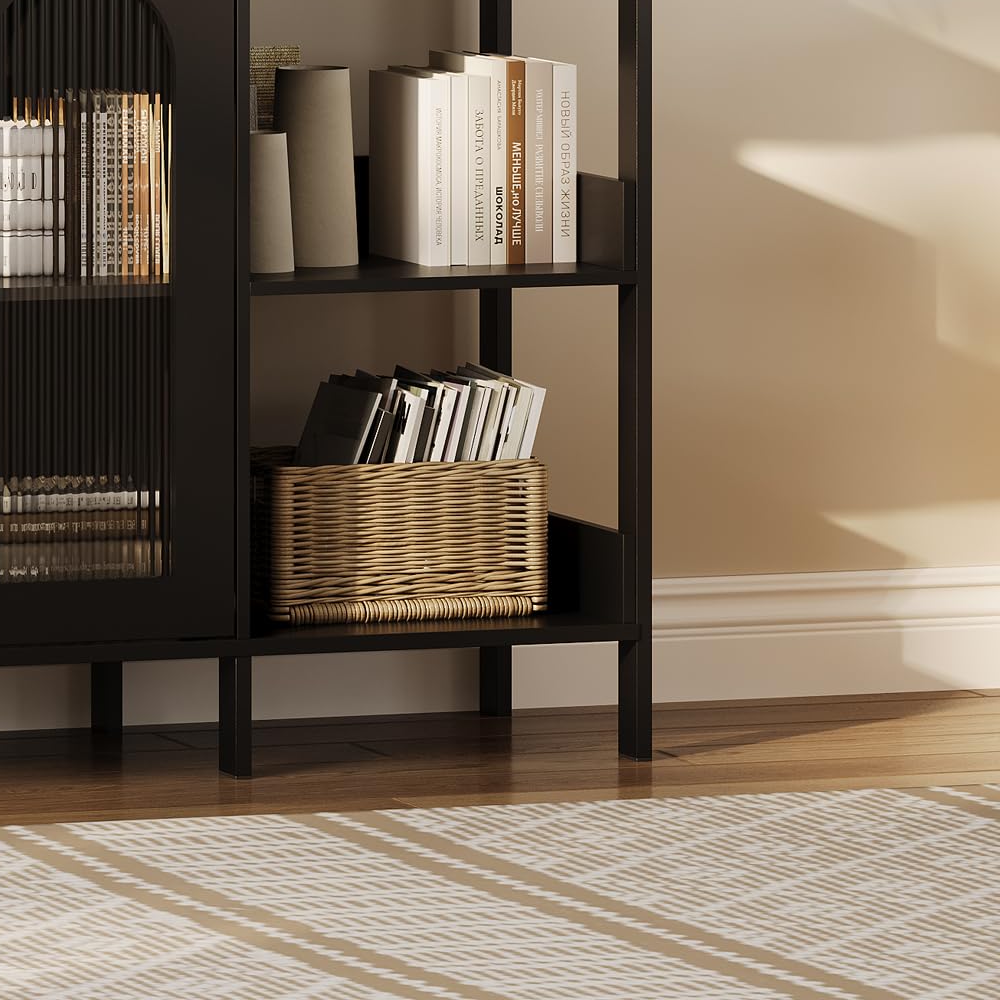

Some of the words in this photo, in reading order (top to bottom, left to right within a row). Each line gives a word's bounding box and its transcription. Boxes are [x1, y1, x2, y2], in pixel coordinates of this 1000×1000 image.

[475, 110, 484, 152] ЗАБОТА
[560, 90, 572, 138] НОВЫЙ
[475, 156, 484, 165] О
[560, 143, 571, 185] ОБРАЗ
[474, 169, 484, 241] ПРЕДАННЫХ
[494, 186, 503, 245] ШОКОЛАД
[511, 207, 522, 246] ЛУЧШЕ
[560, 188, 571, 237] ЖИЗНИ
